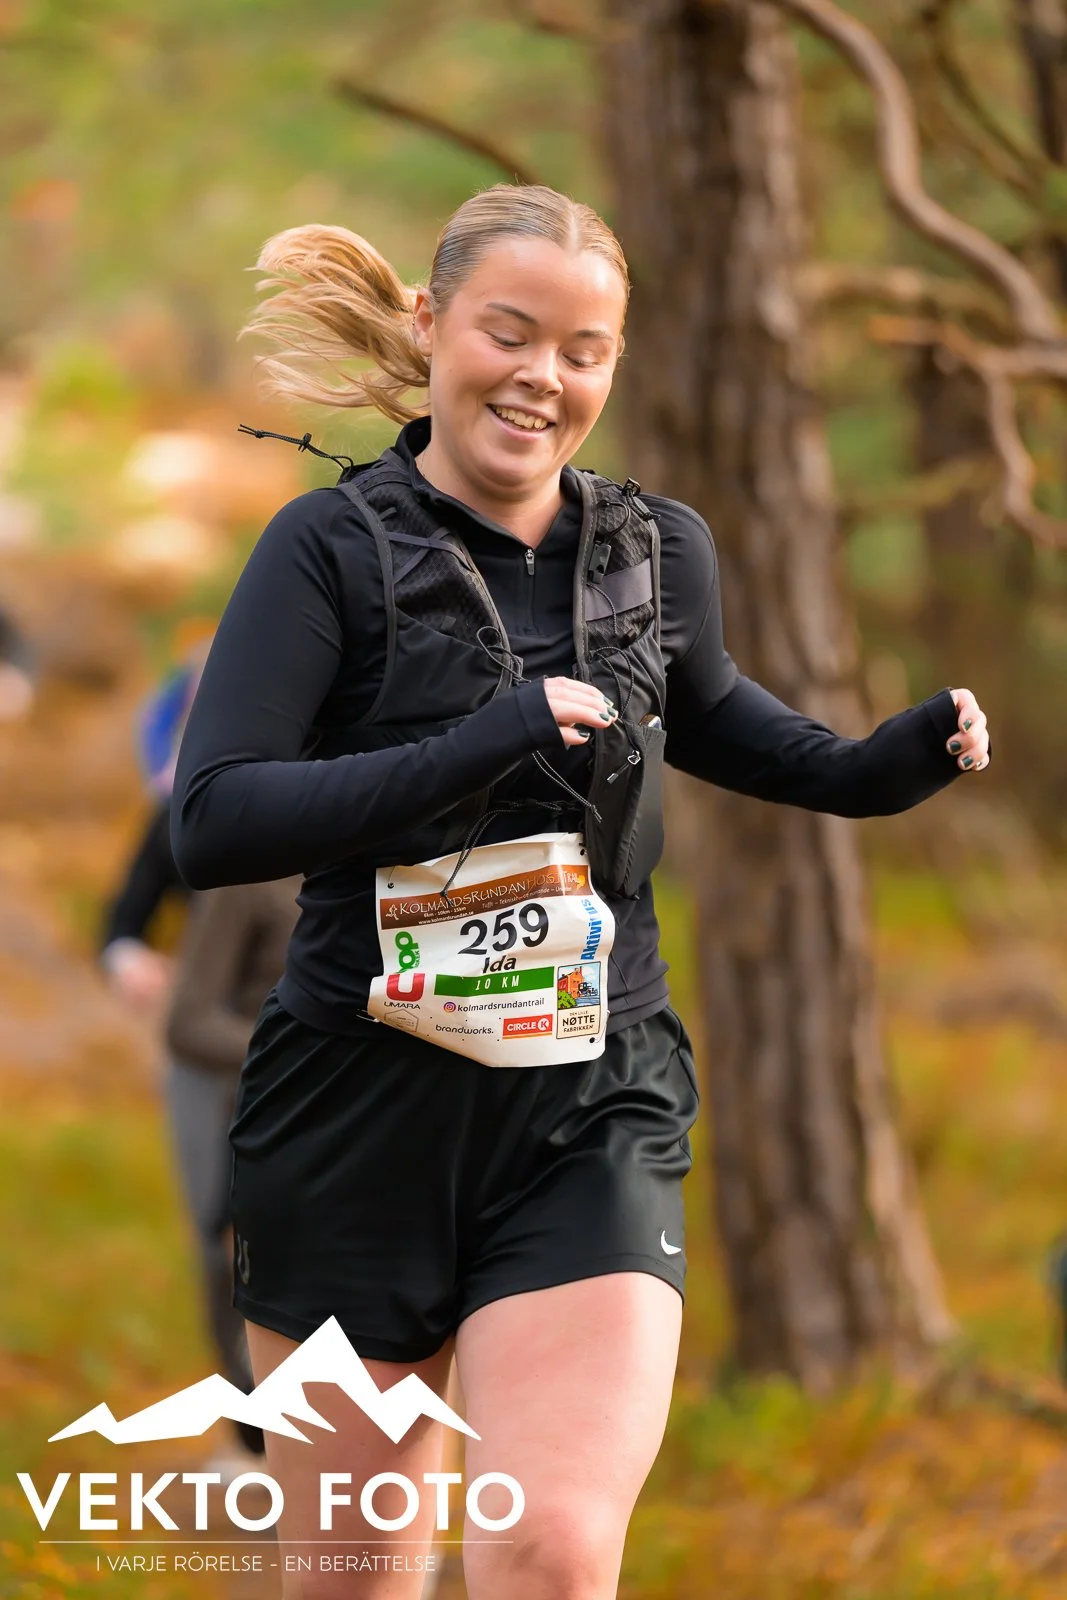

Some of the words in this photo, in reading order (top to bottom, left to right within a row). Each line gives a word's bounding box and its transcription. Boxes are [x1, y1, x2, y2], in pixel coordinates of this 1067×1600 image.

[457, 902, 549, 955] 259
[580, 899, 602, 960] Aktivius
[482, 955, 517, 974] Ida
[475, 978, 491, 991] 10
[502, 975, 519, 988] KM
[384, 1001, 421, 1010] UMARA
[457, 998, 544, 1012] kolmardsrundantrail
[507, 1021, 537, 1032] CIRCLE
[562, 1014, 595, 1027] NØTTE
[436, 1024, 494, 1035] brandworks.
[563, 1024, 593, 1033] FABRIKKEN
